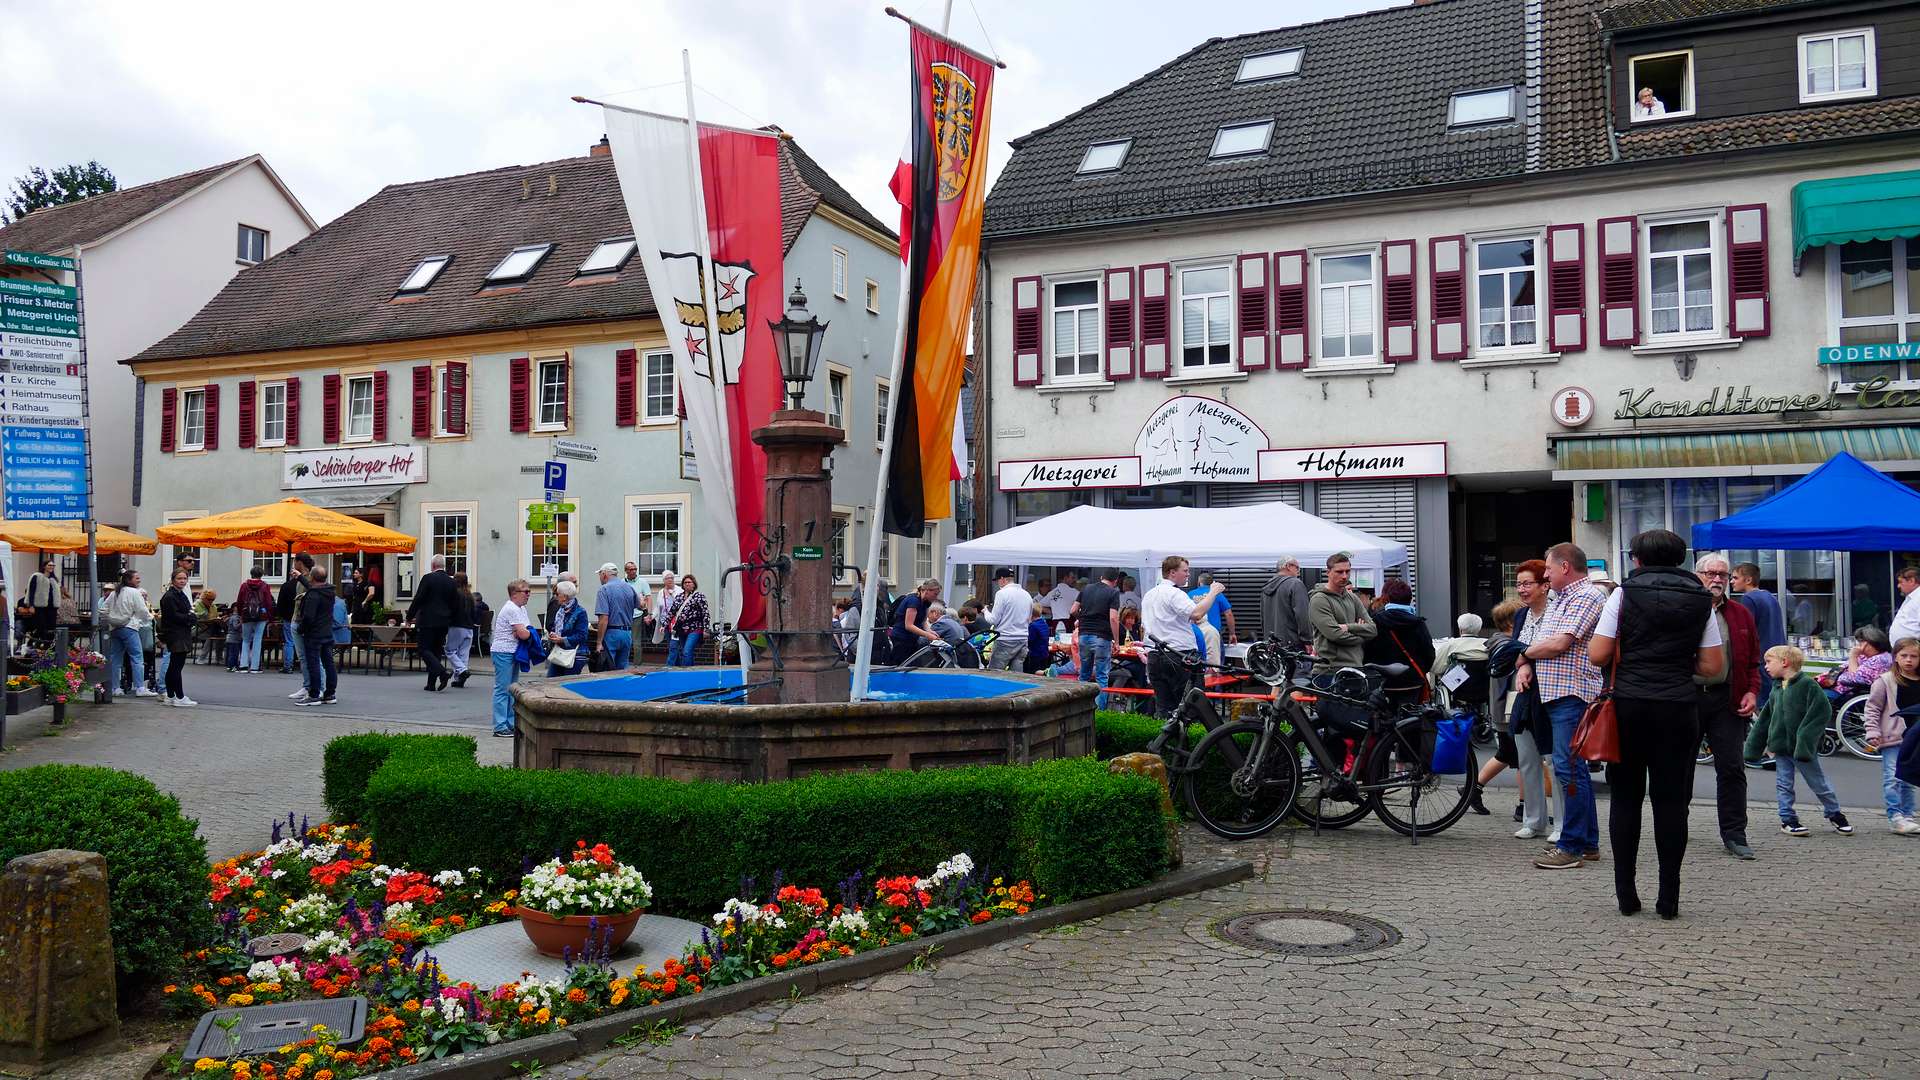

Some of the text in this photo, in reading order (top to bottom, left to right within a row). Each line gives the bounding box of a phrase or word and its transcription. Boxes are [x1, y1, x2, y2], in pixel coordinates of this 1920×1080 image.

[12, 252, 29, 264] Obst
[34, 256, 60, 267] Gemüse
[0, 281, 65, 296] Brunnen-Apotheke
[3, 294, 33, 306] Friseur
[44, 300, 74, 310] Metzler
[7, 308, 53, 321] Metzgerei
[21, 323, 34, 331] Obst
[46, 325, 68, 334] Gemüse
[12, 362, 61, 374] Verkehrsbüro
[11, 376, 56, 386] Ev. Kirche
[11, 389, 80, 401] Heimatmuseum
[1614, 375, 1920, 418] Konditorei Ca
[12, 402, 49, 412] Rathaus
[7, 416, 80, 426] Ev. Kindertagesstätte
[1145, 403, 1179, 448] Metzgerei
[1188, 401, 1252, 435] Metzgerei
[312, 452, 415, 483] Schönberger Hof
[1190, 461, 1250, 479] Hofmann
[1297, 450, 1404, 477] Hofmann
[548, 465, 563, 487] P
[1021, 464, 1118, 487] Metzgerei
[1146, 463, 1182, 481] Hofmann
[18, 497, 60, 506] Eisparadies
[16, 510, 86, 518] China-Thai-Restaurant
